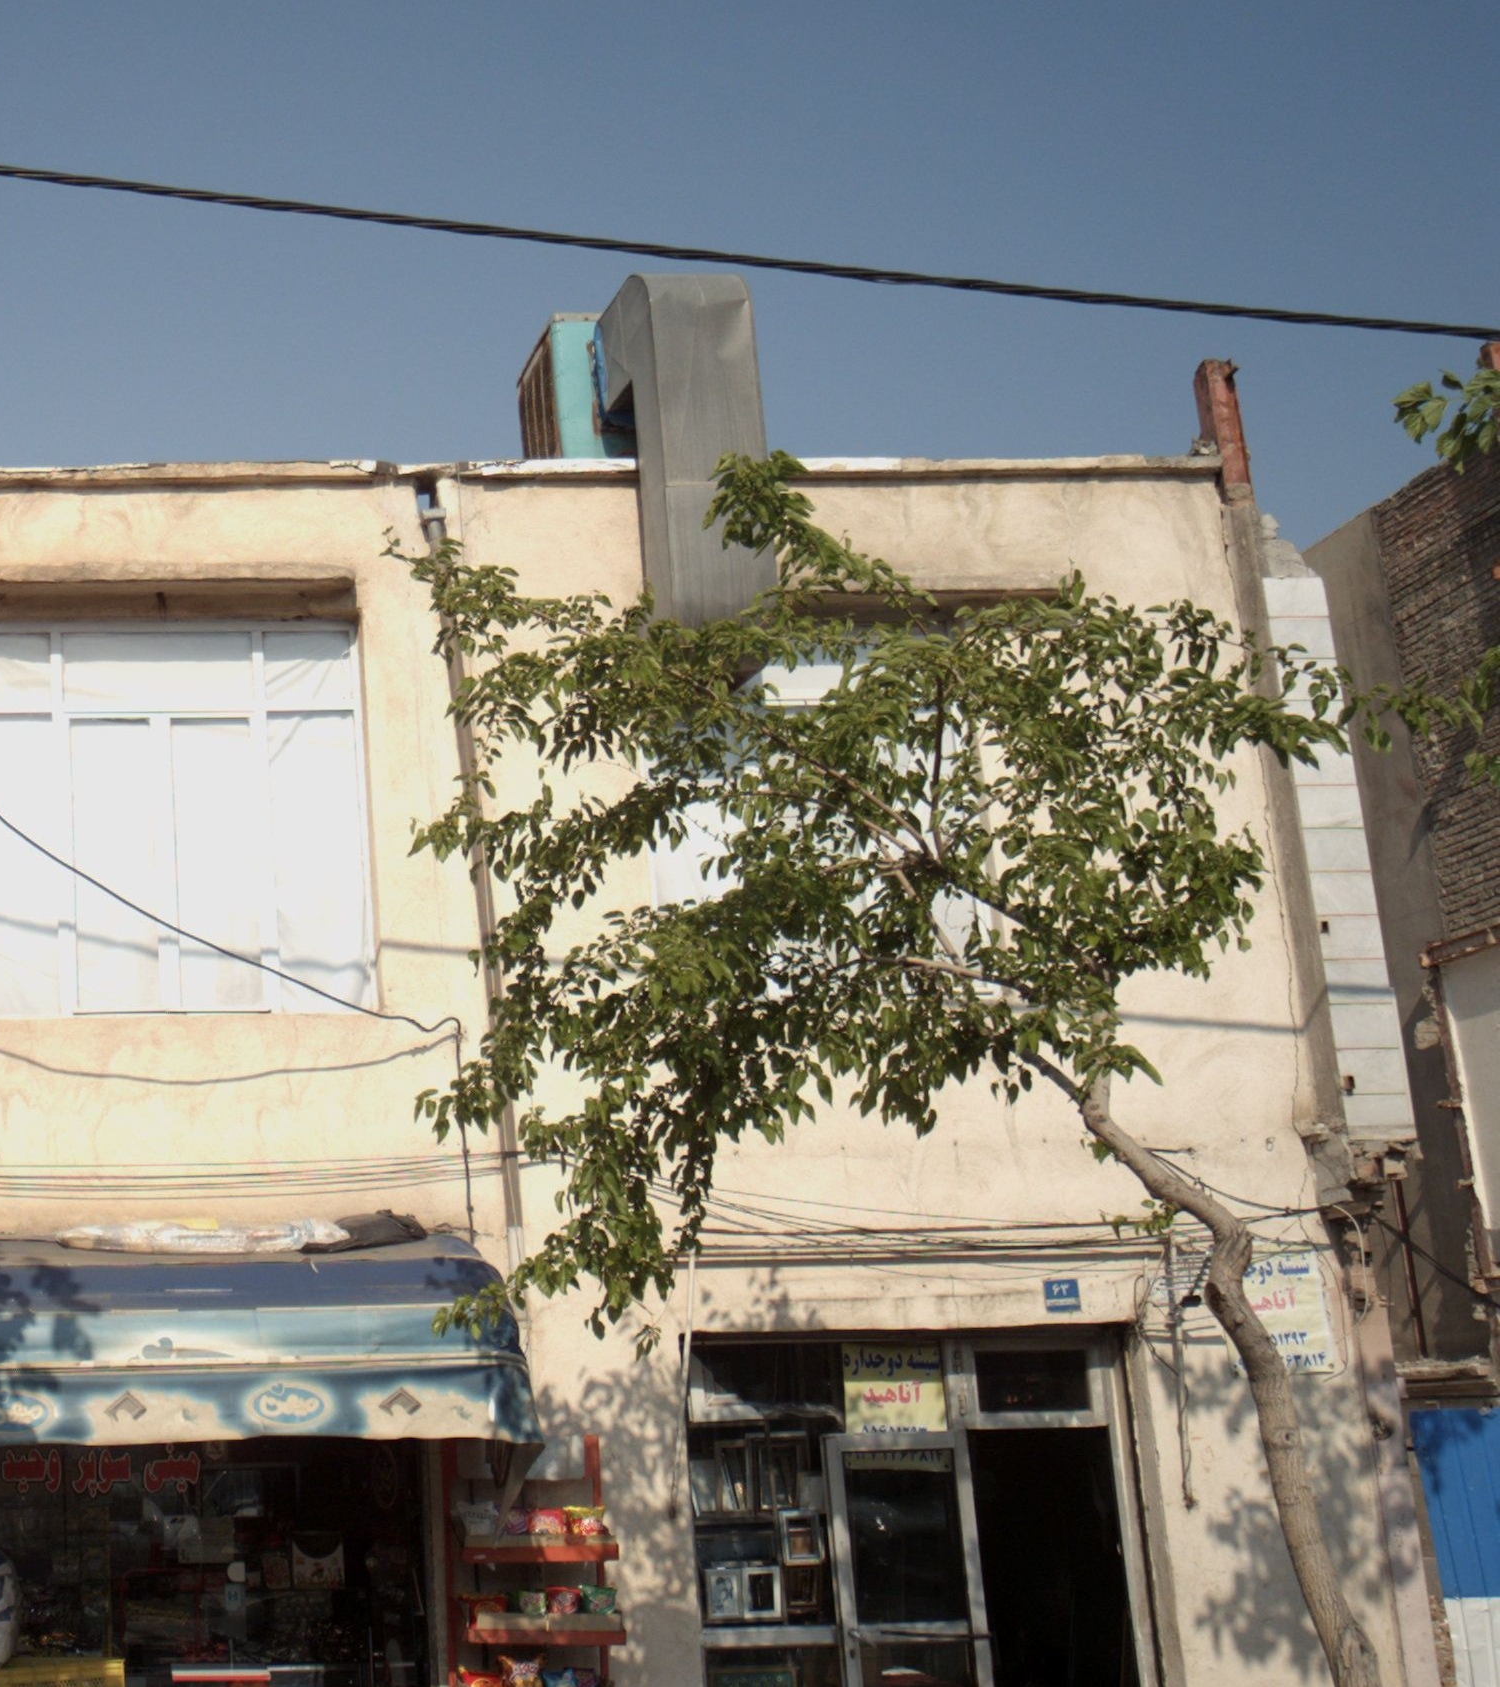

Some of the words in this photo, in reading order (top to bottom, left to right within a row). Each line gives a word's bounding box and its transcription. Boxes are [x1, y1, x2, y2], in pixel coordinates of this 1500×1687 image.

[1251, 1287, 1296, 1311] آناهی
[842, 1347, 885, 1376] جداره
[887, 1353, 903, 1377] دو
[906, 1349, 940, 1376] شیشه
[862, 1380, 921, 1408] آناهید
[2, 1449, 62, 1494] وحید
[72, 1450, 131, 1499] سوپر
[144, 1444, 200, 1493] مینی
